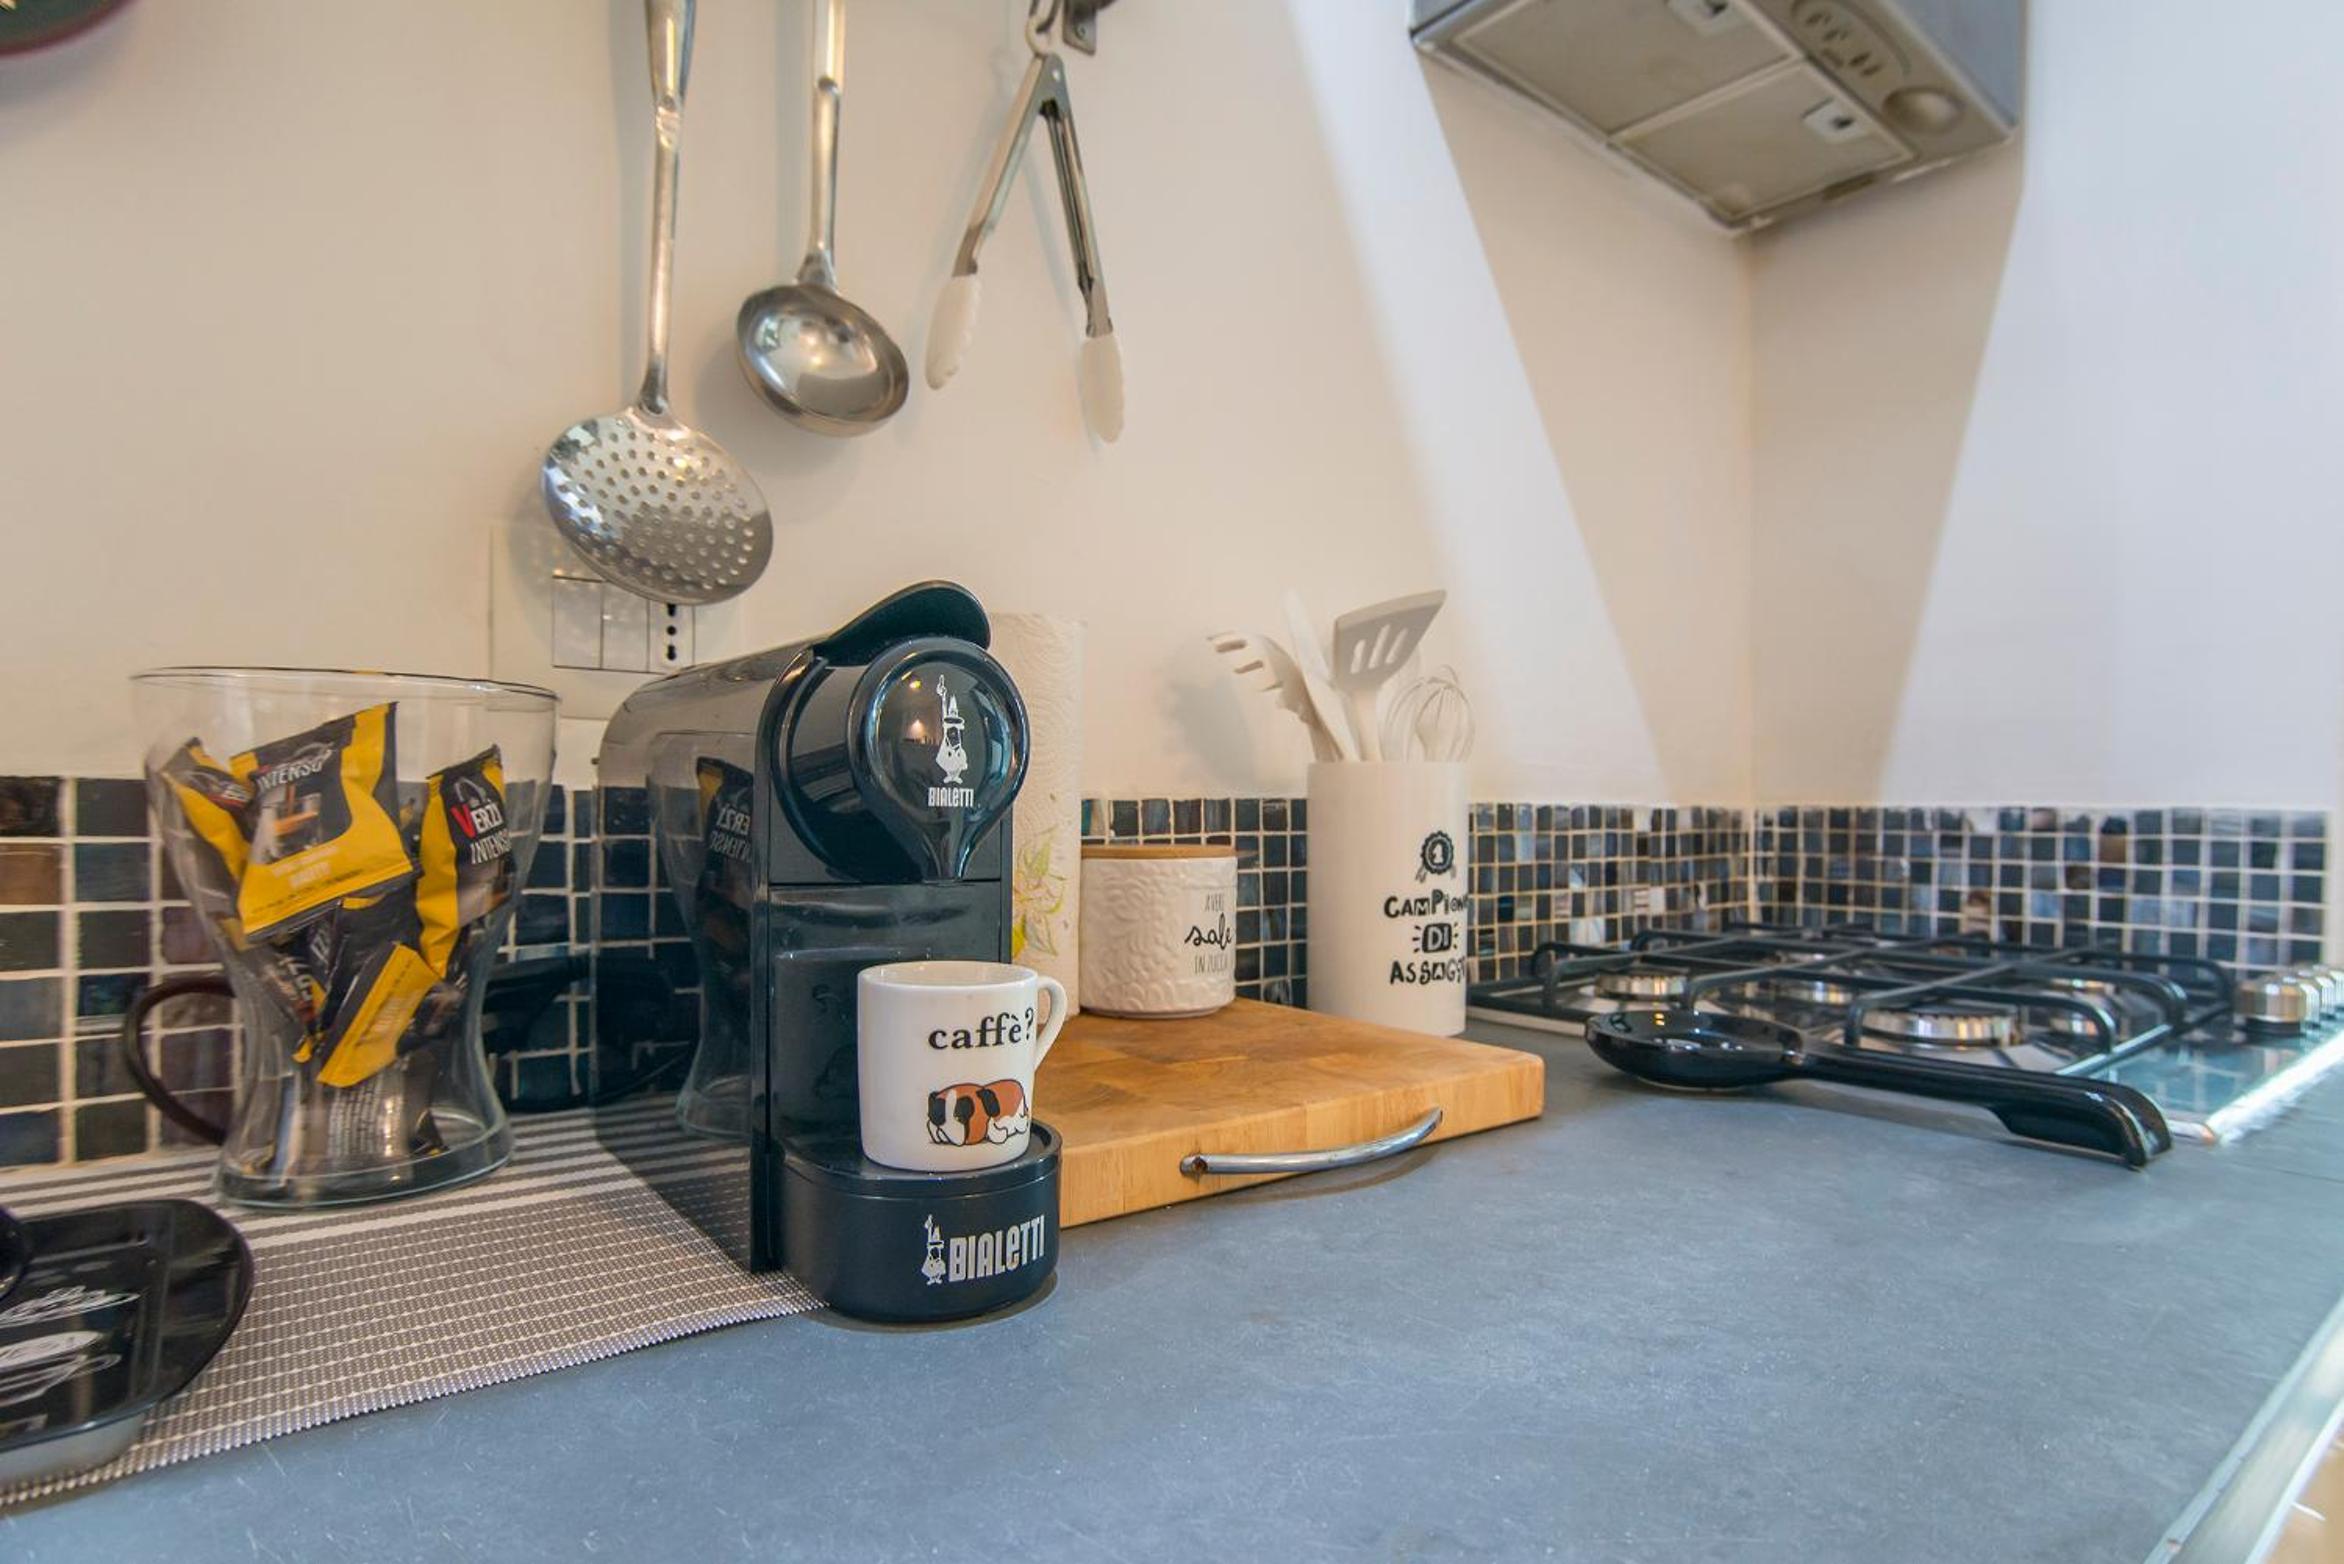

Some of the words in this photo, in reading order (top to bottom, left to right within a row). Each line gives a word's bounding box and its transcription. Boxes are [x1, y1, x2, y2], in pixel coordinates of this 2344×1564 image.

[1184, 912, 1232, 951] sale
[1427, 926, 1450, 951] DI
[928, 1006, 1034, 1051] caffè?
